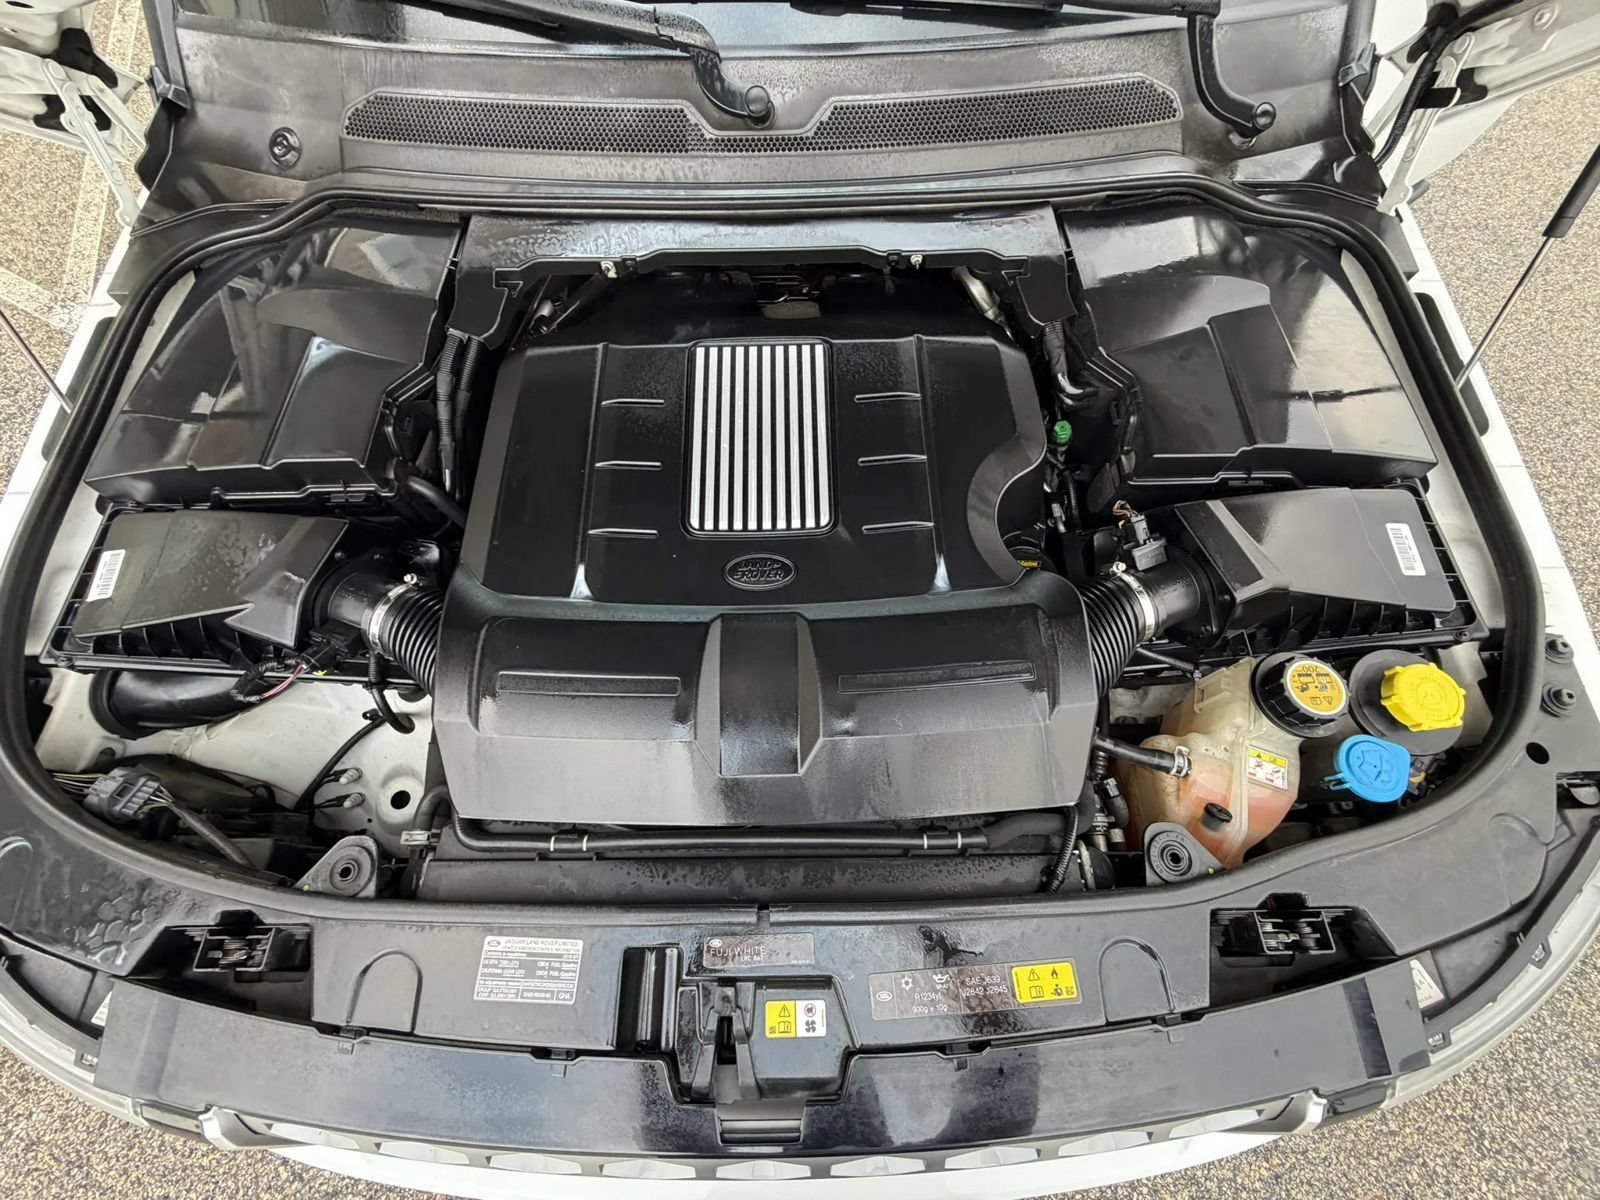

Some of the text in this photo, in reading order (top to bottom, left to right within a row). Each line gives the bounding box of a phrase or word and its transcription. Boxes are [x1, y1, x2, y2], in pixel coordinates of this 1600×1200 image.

[738, 561, 774, 570] LAND
[740, 570, 784, 581] ROVER
[709, 945, 766, 957] FUJI WHITE
[965, 975, 1001, 985] SAE J639
[961, 985, 1009, 997] J2842 J2845
[912, 1004, 929, 1014] 900g
[935, 1003, 948, 1013] 10g
